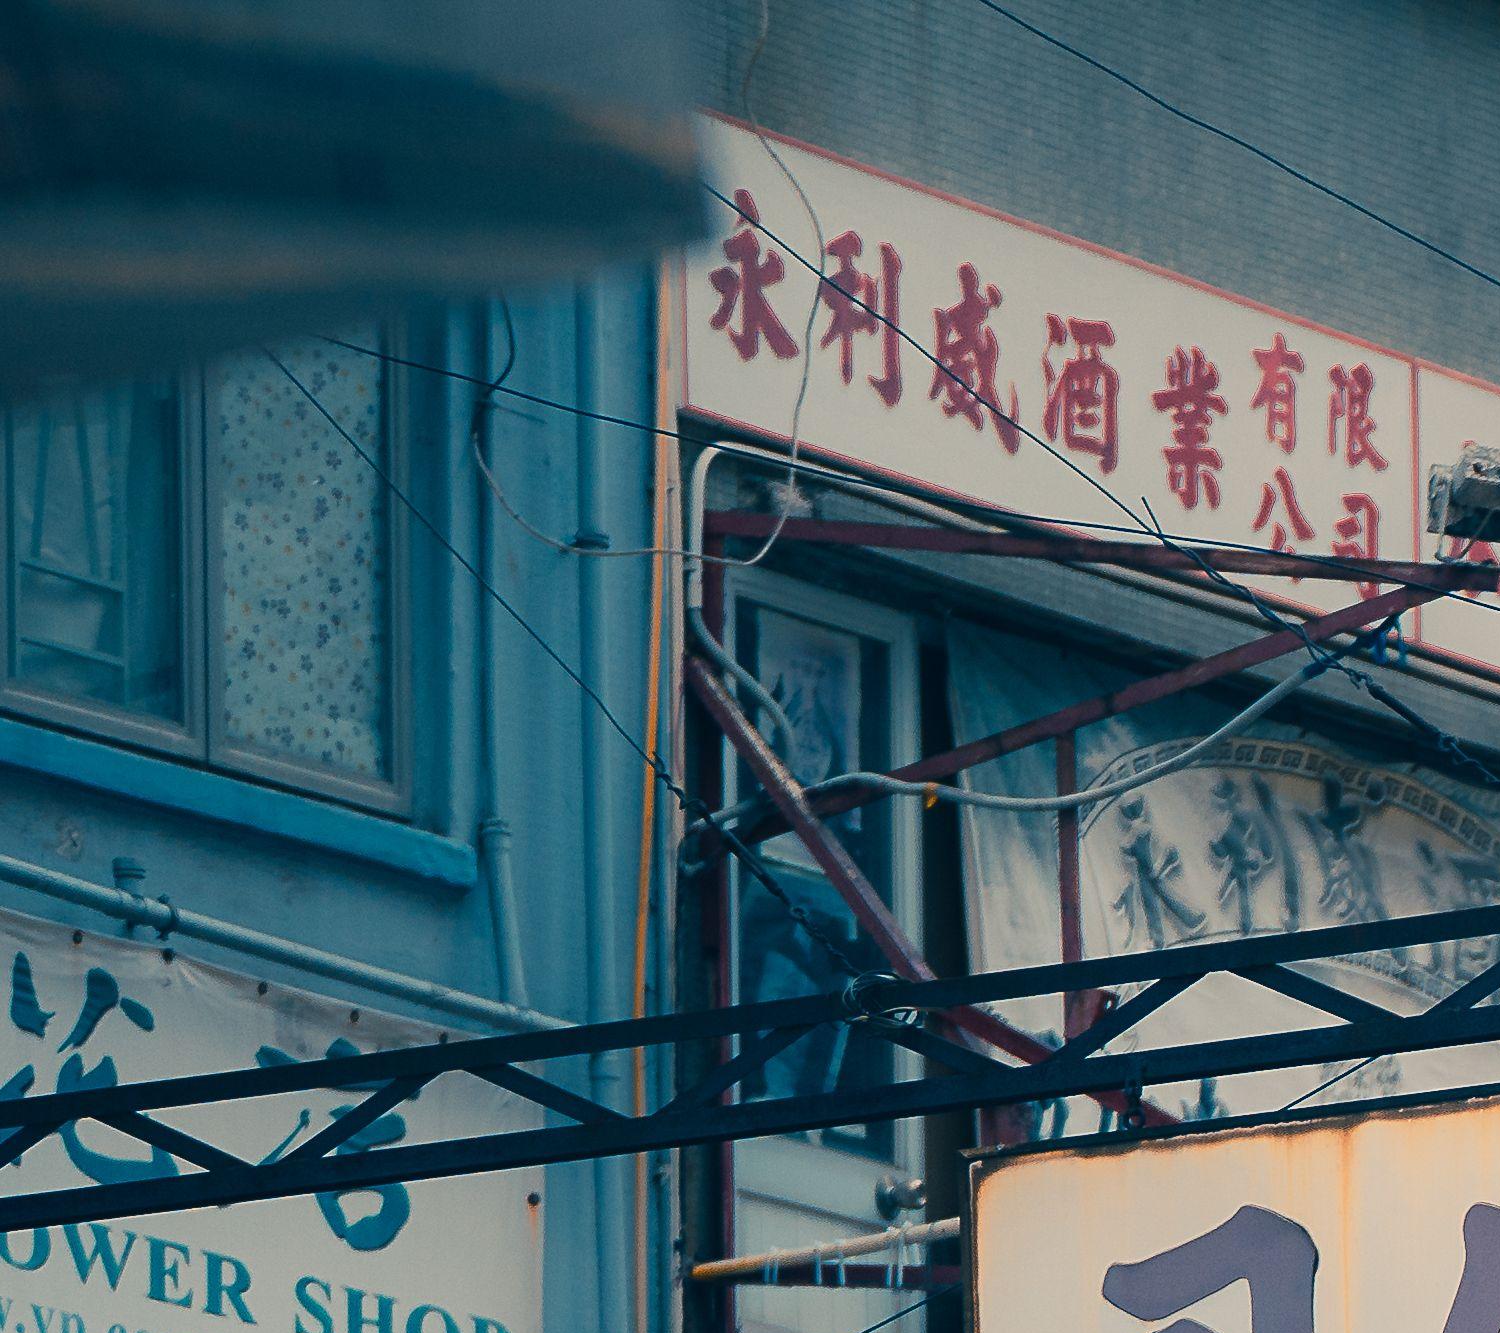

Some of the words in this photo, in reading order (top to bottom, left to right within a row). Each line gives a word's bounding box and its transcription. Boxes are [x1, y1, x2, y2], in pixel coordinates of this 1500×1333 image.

[708, 187, 1228, 512] 永利威酒業
[1250, 330, 1390, 474] 有限
